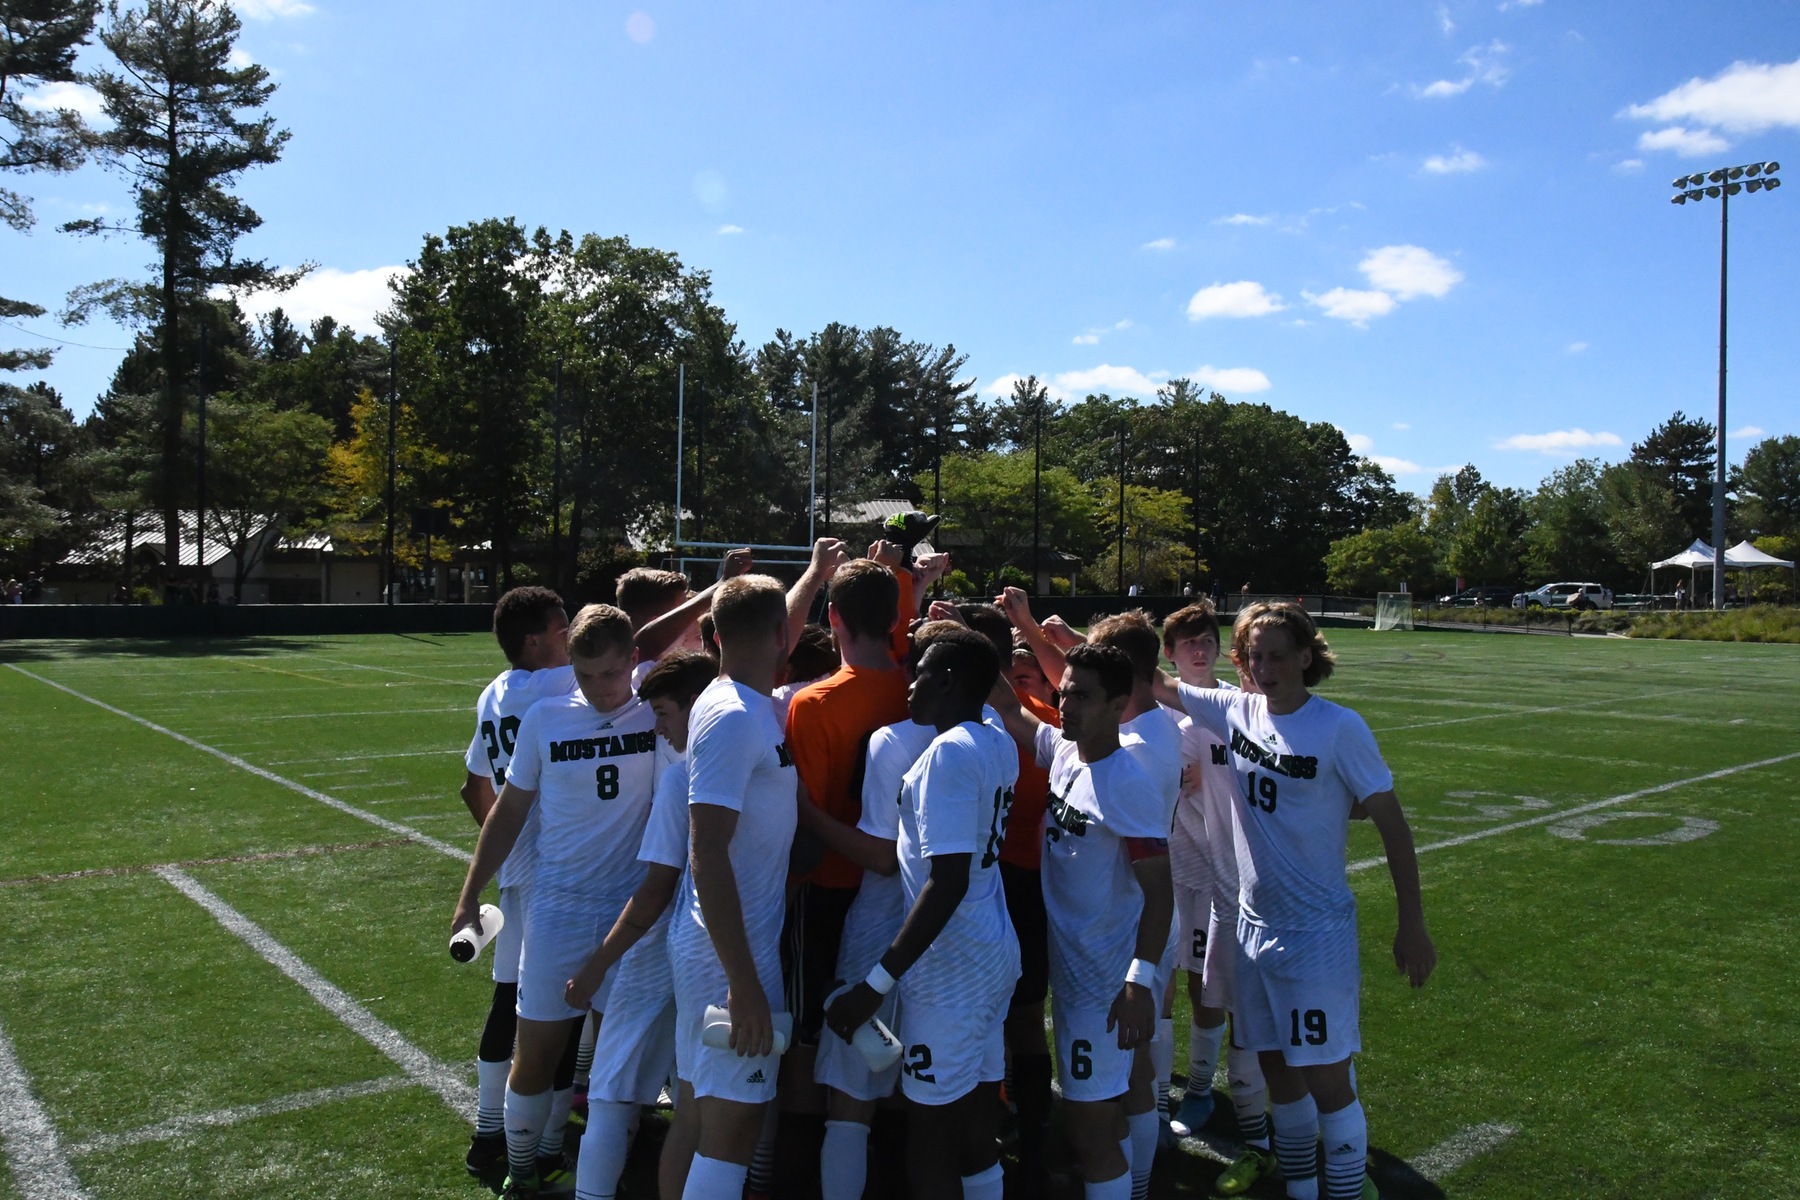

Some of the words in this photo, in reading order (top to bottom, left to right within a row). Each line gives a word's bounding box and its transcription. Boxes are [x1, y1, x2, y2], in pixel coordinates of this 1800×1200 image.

[596, 764, 619, 800] 8
[1247, 770, 1277, 814] 19
[1291, 1008, 1328, 1046] 19
[901, 1044, 936, 1084] 2
[1071, 1039, 1093, 1080] 6
